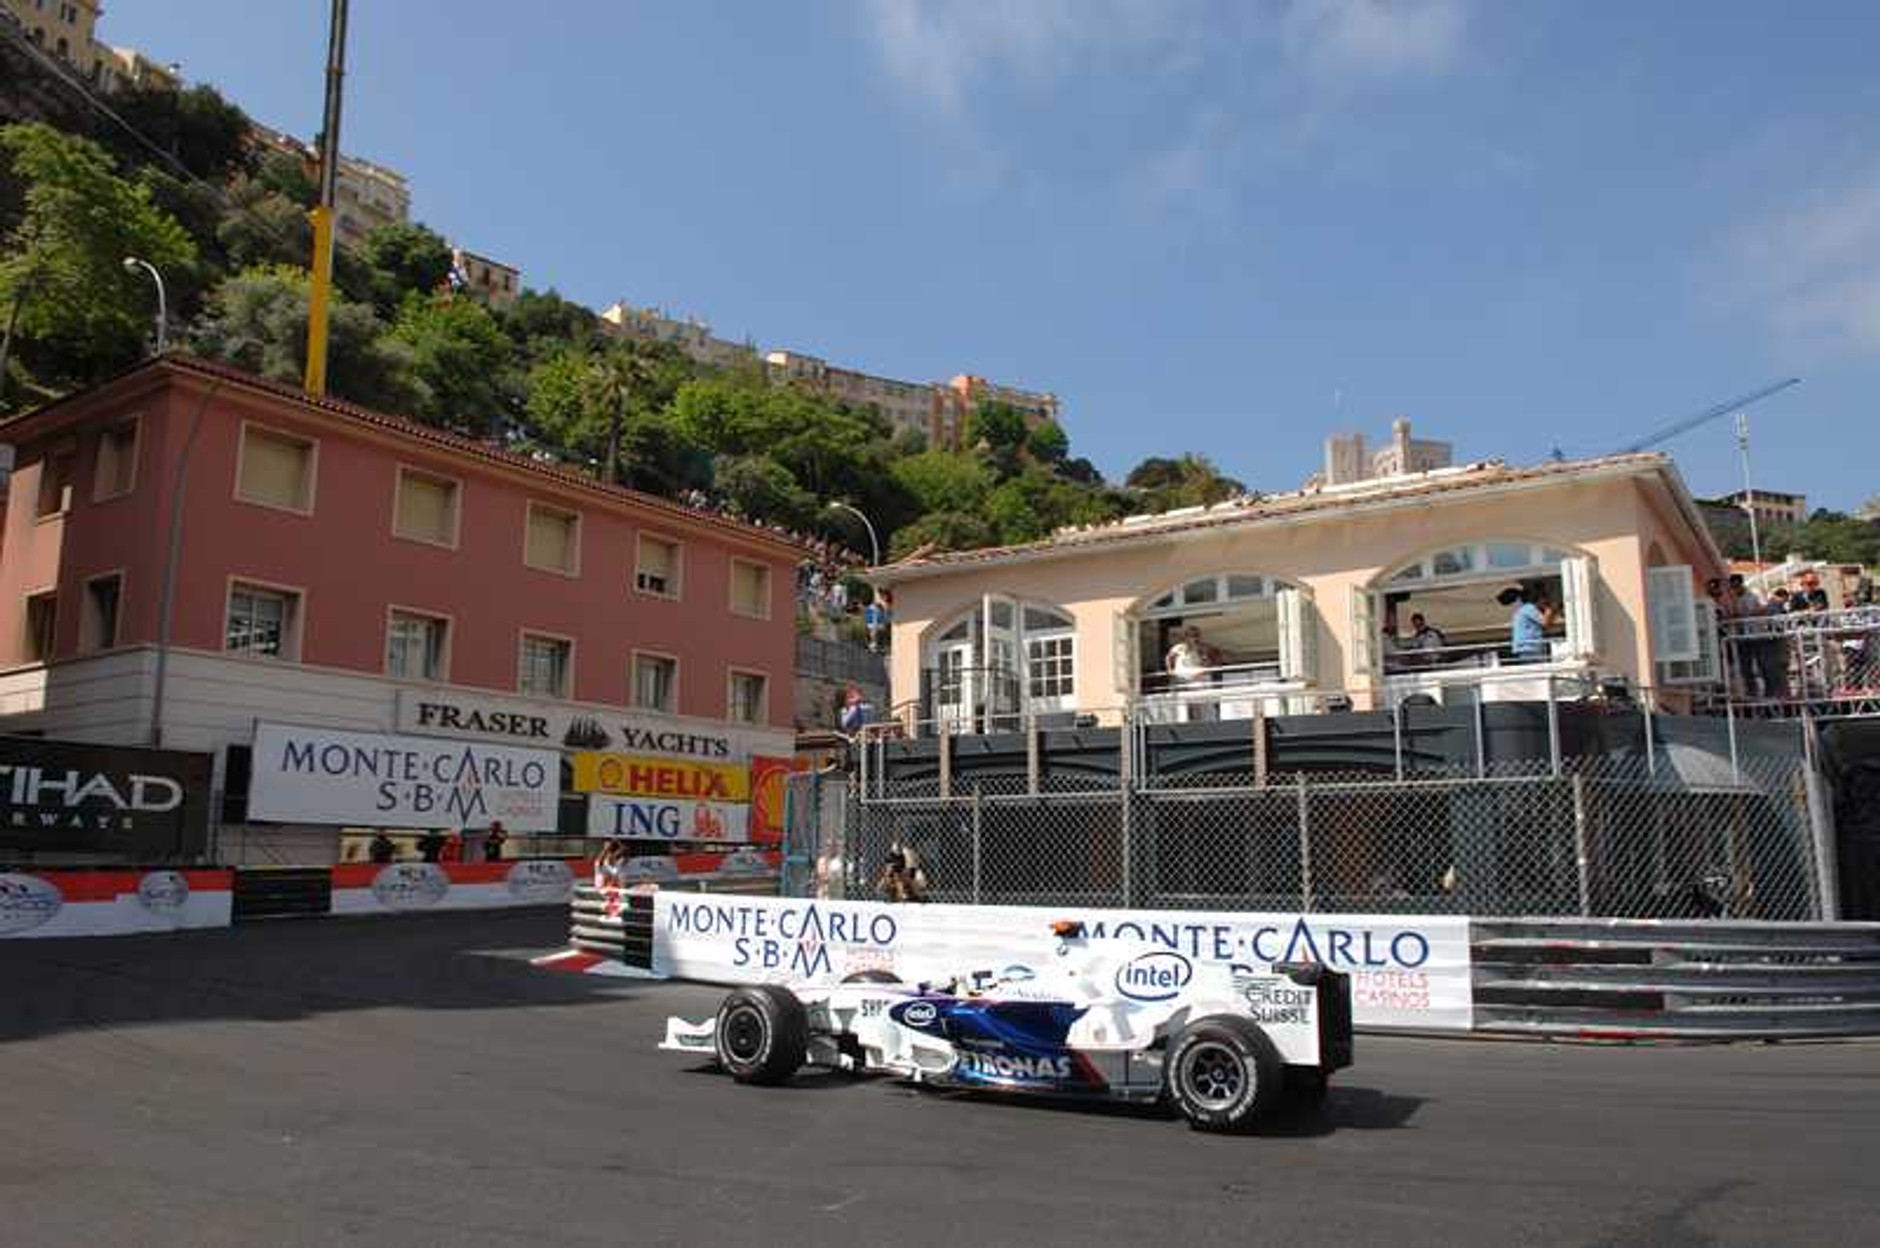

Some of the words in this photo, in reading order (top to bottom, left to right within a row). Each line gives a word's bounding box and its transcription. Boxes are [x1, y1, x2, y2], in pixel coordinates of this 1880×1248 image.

[417, 702, 549, 738] FRASER
[621, 727, 728, 757] YACHTS
[629, 764, 730, 796] HELIX
[610, 803, 680, 838] ING
[1126, 960, 1179, 987] intel
[1355, 970, 1429, 988] HOTELS
